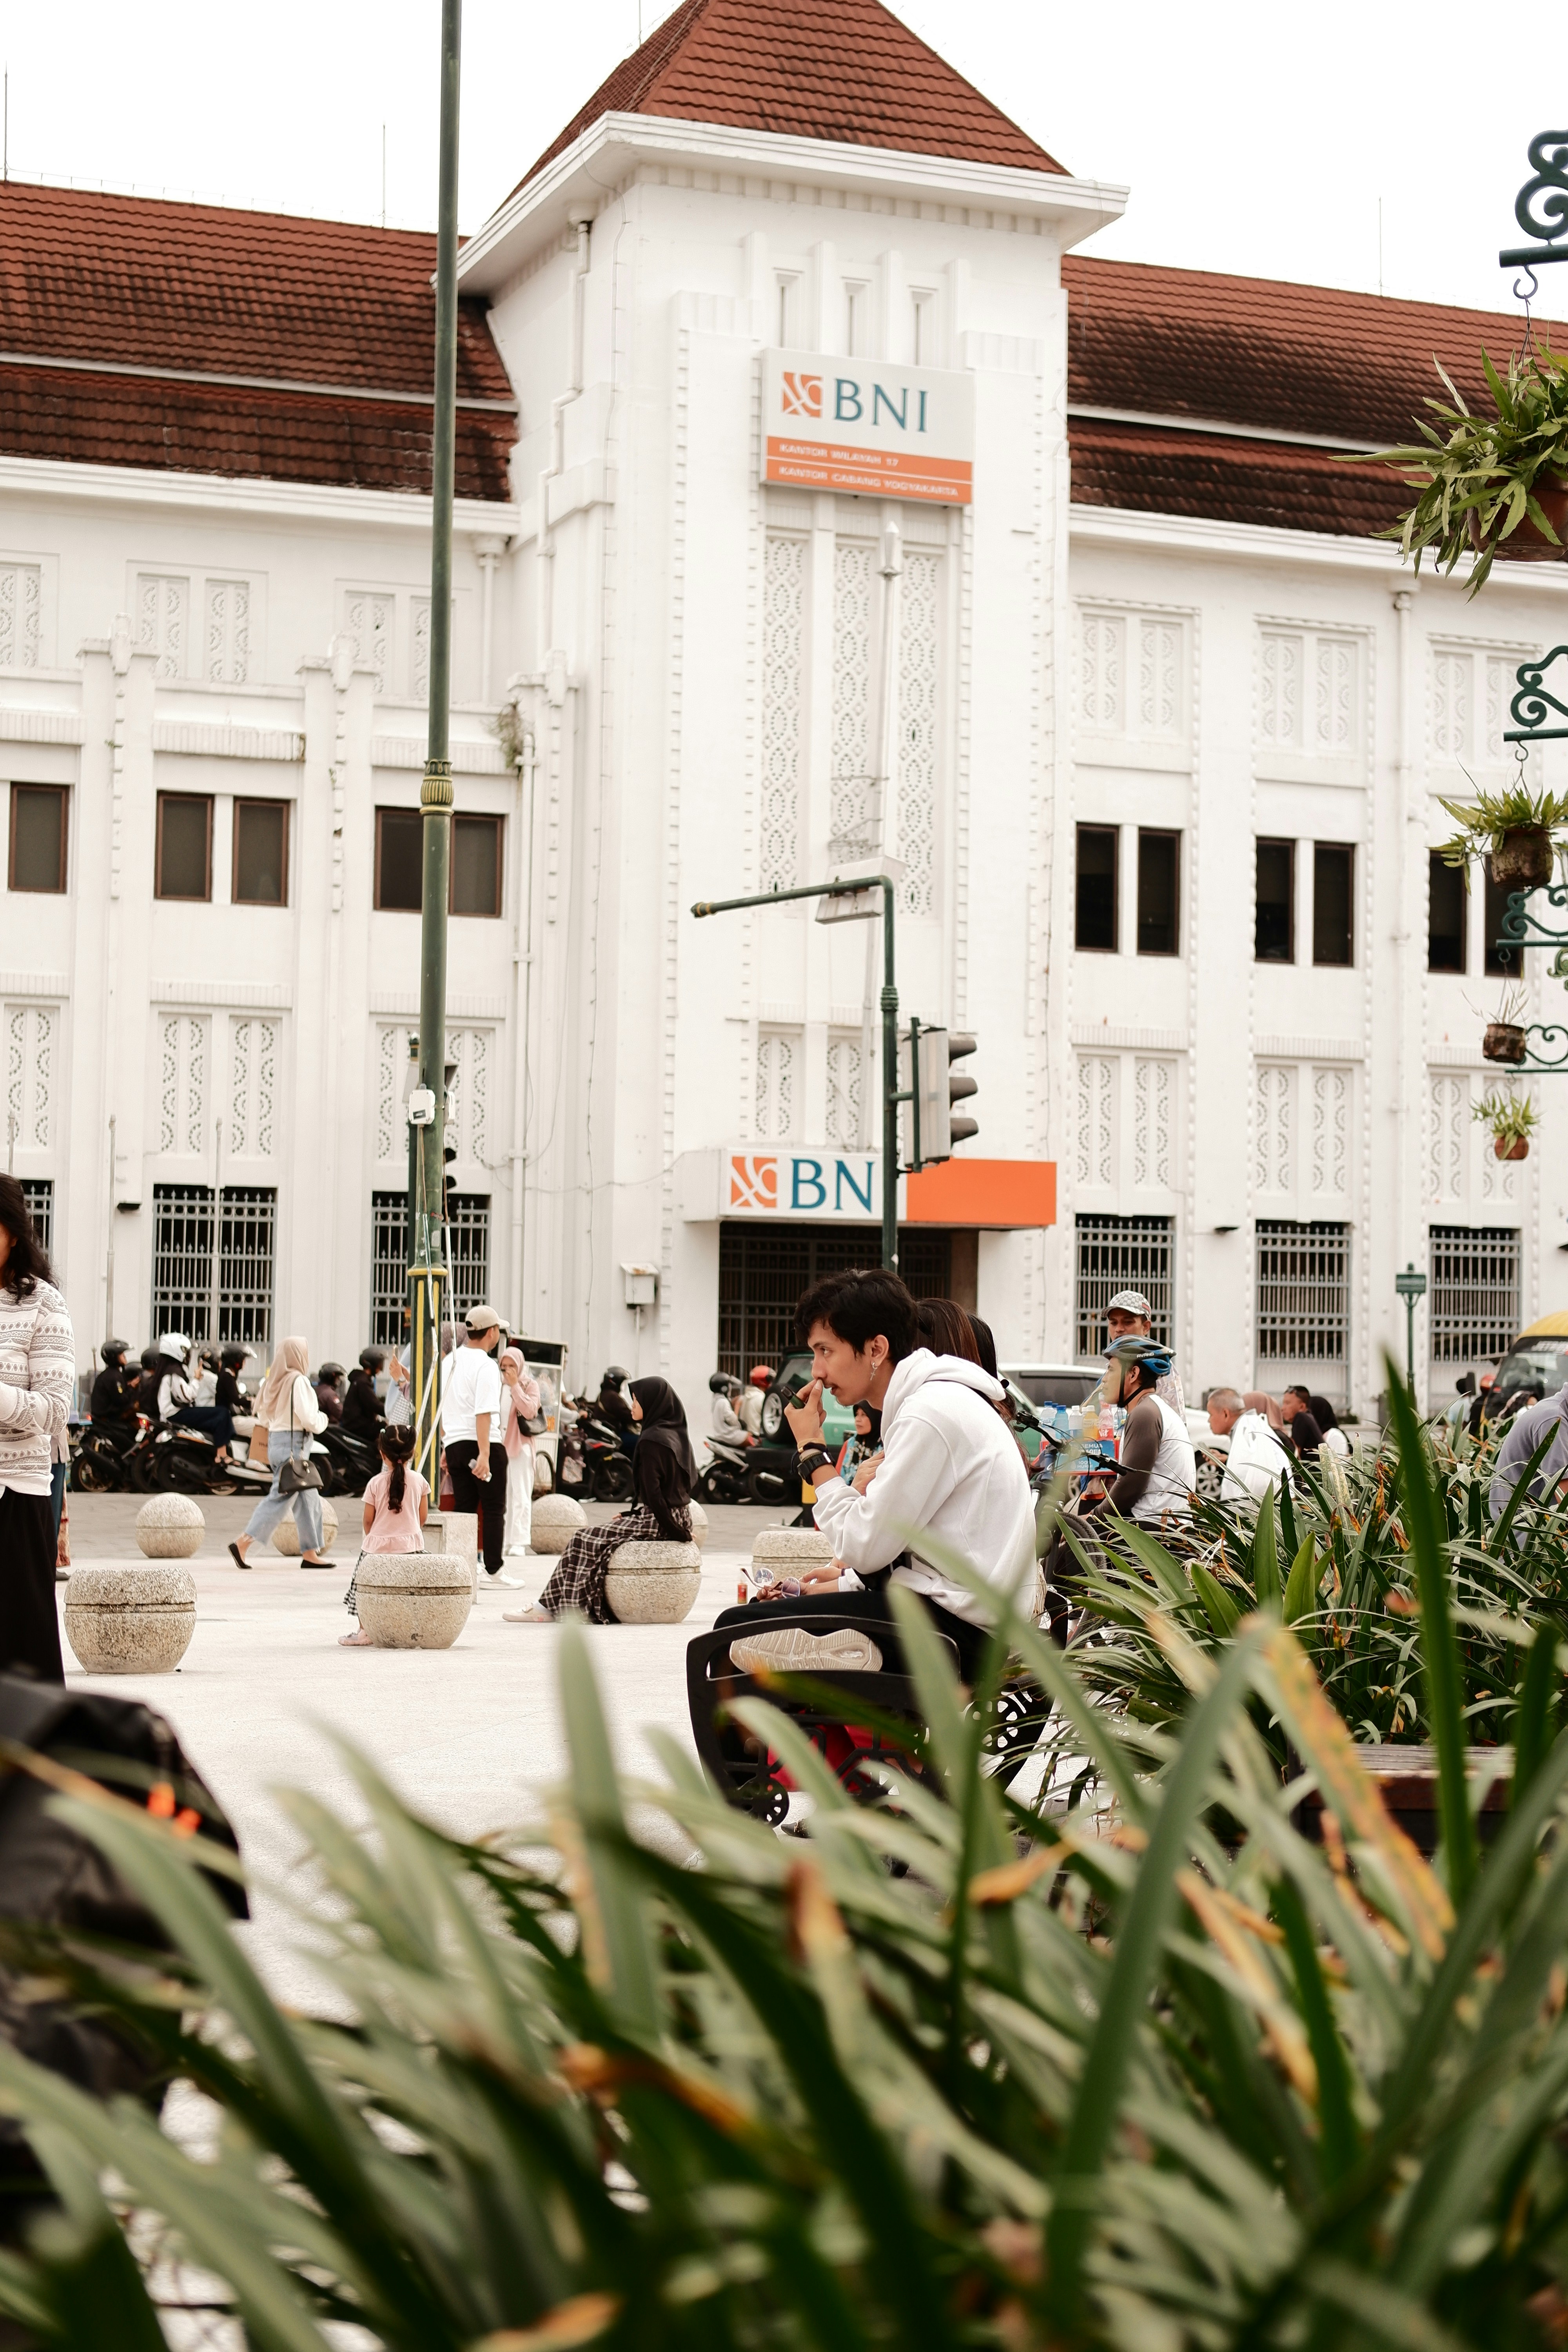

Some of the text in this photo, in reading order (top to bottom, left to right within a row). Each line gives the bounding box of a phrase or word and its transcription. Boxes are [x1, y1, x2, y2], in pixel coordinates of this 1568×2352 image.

[835, 378, 928, 432] BNI
[779, 443, 828, 457] KANTOR
[831, 450, 882, 464] WILAYAH
[779, 466, 958, 496] KANTOR CABANG YOGYAKARTA
[790, 1158, 875, 1213] BN
